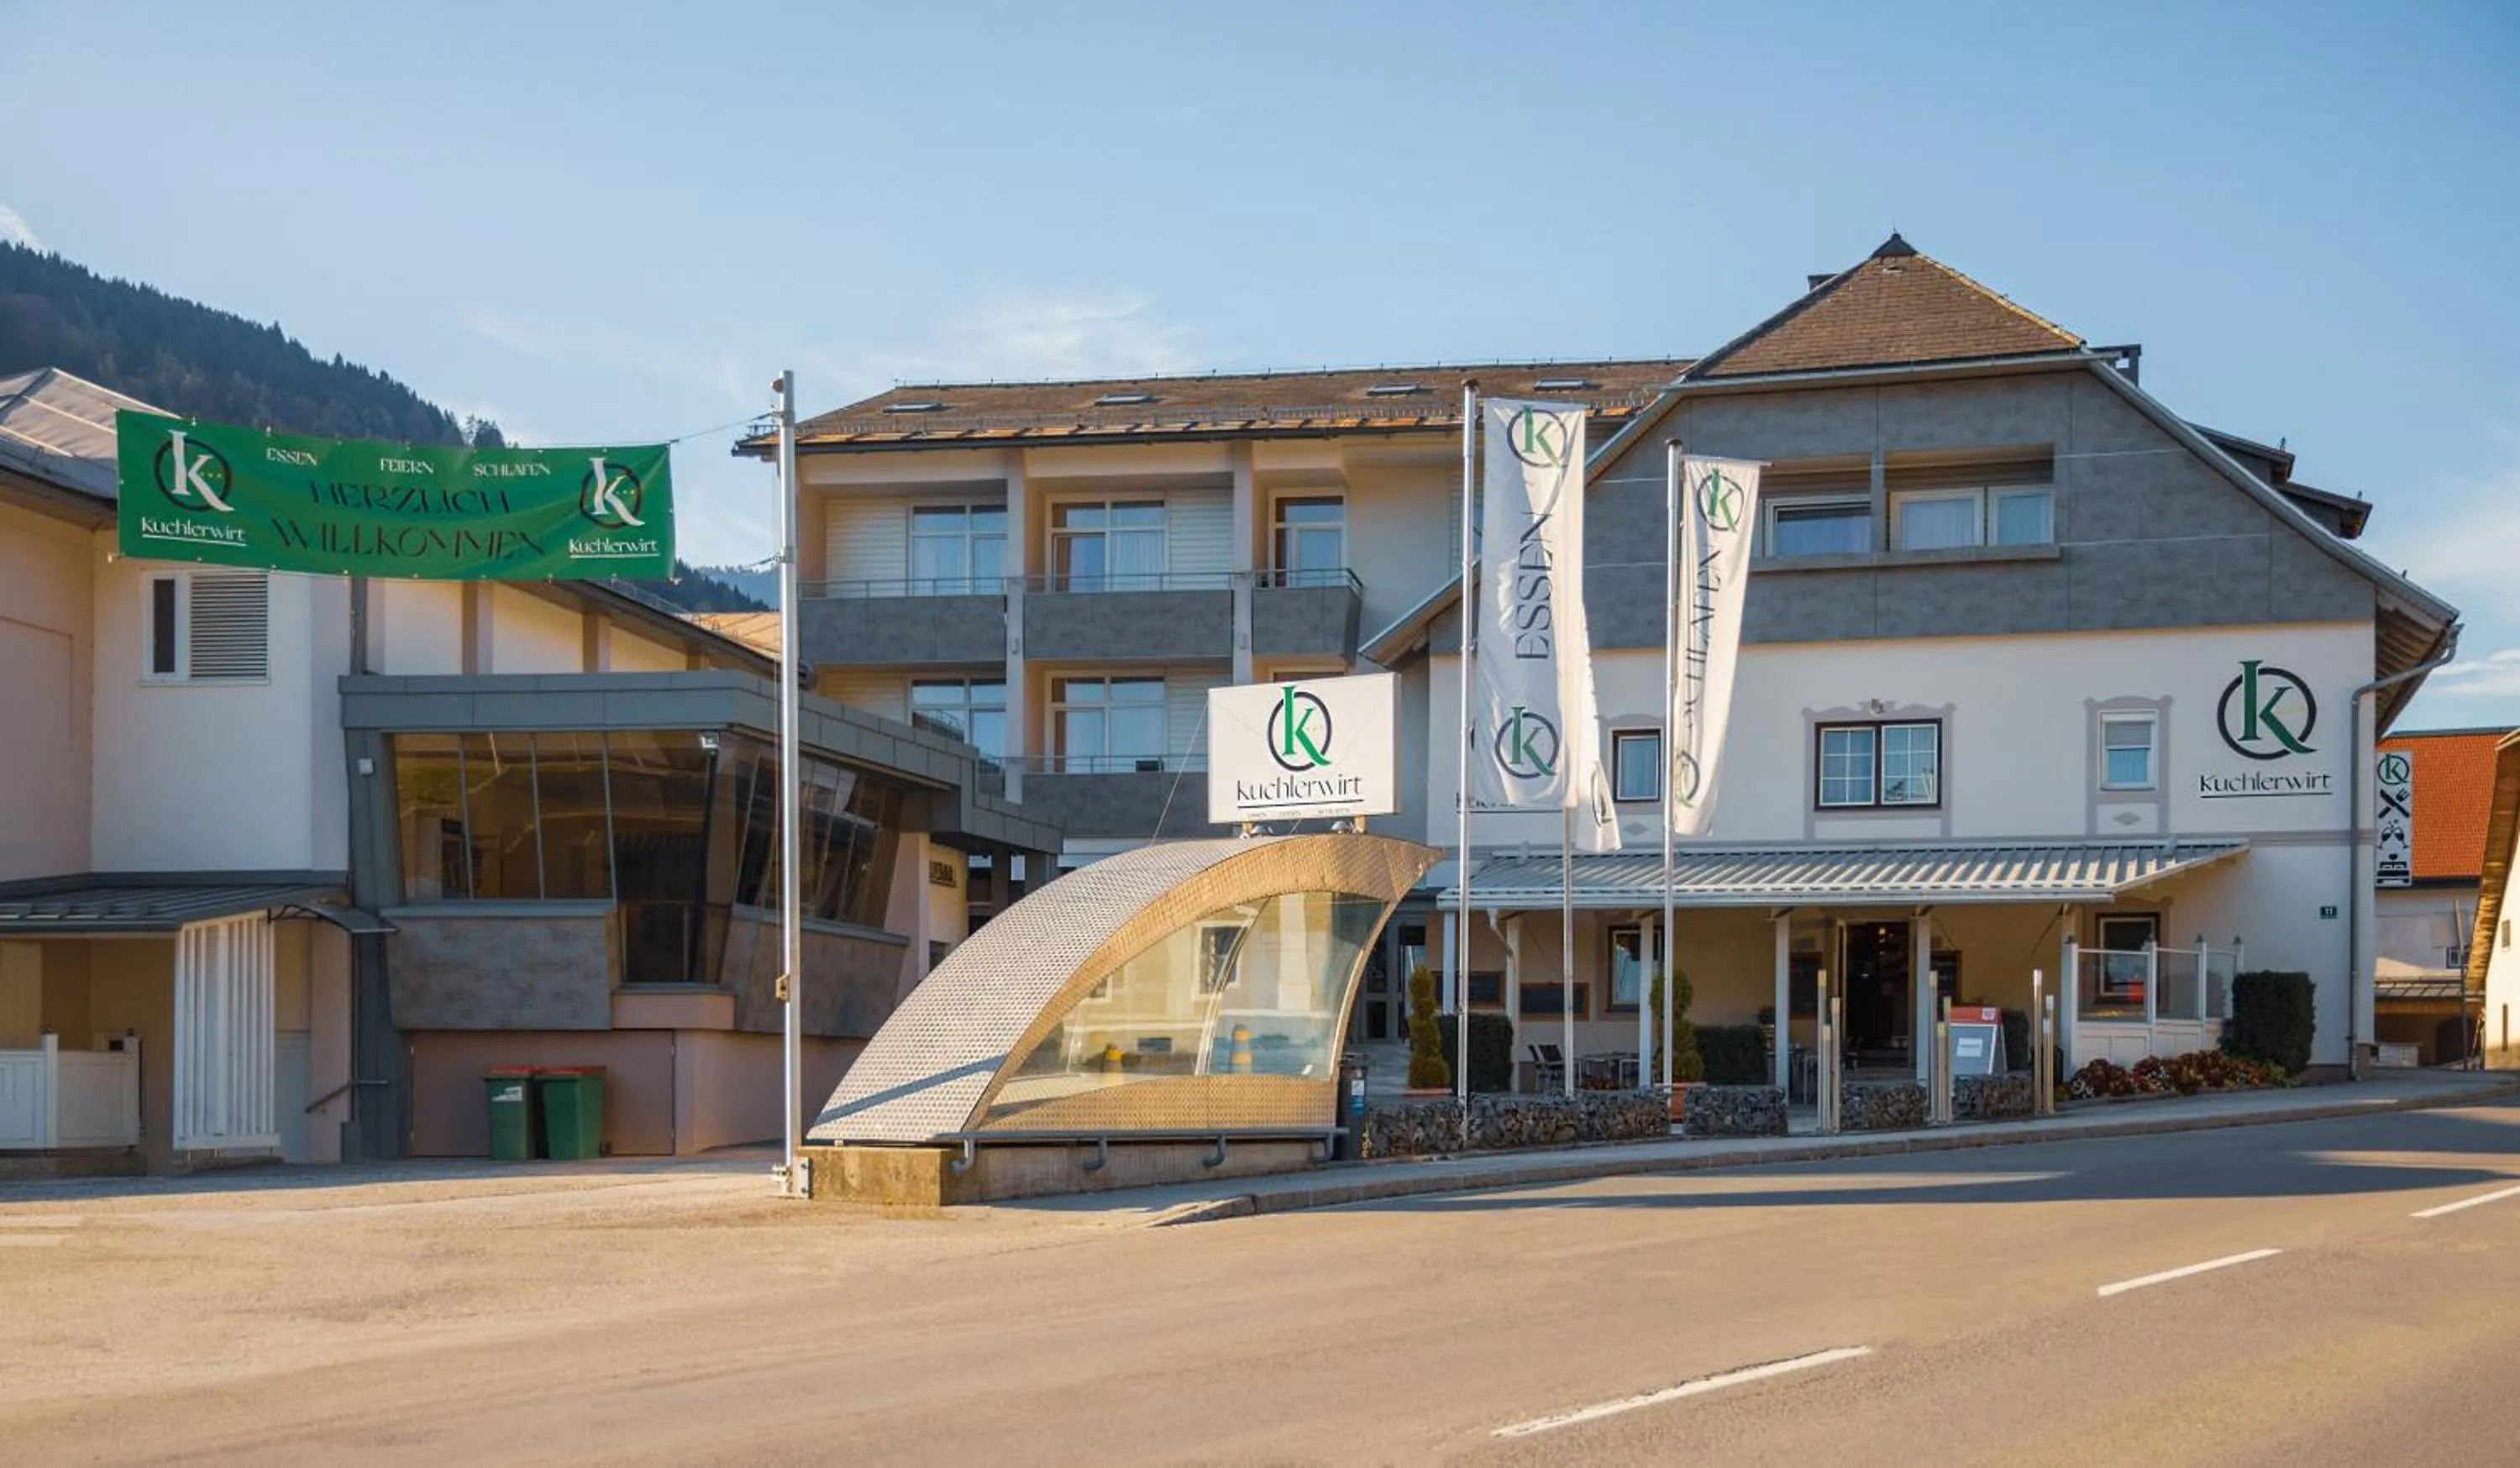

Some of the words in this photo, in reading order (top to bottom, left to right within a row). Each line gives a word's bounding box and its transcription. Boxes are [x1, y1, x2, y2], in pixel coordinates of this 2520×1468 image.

[265, 447, 318, 466] ESSEN
[380, 458, 434, 474] FEIERN
[473, 463, 551, 477] SCHLAFEN
[309, 479, 511, 514] HERZLICH
[270, 516, 546, 559] WILLKOMMEN
[1515, 510, 1554, 659] ESSEN
[2199, 770, 2333, 792] Kuchlerwirt
